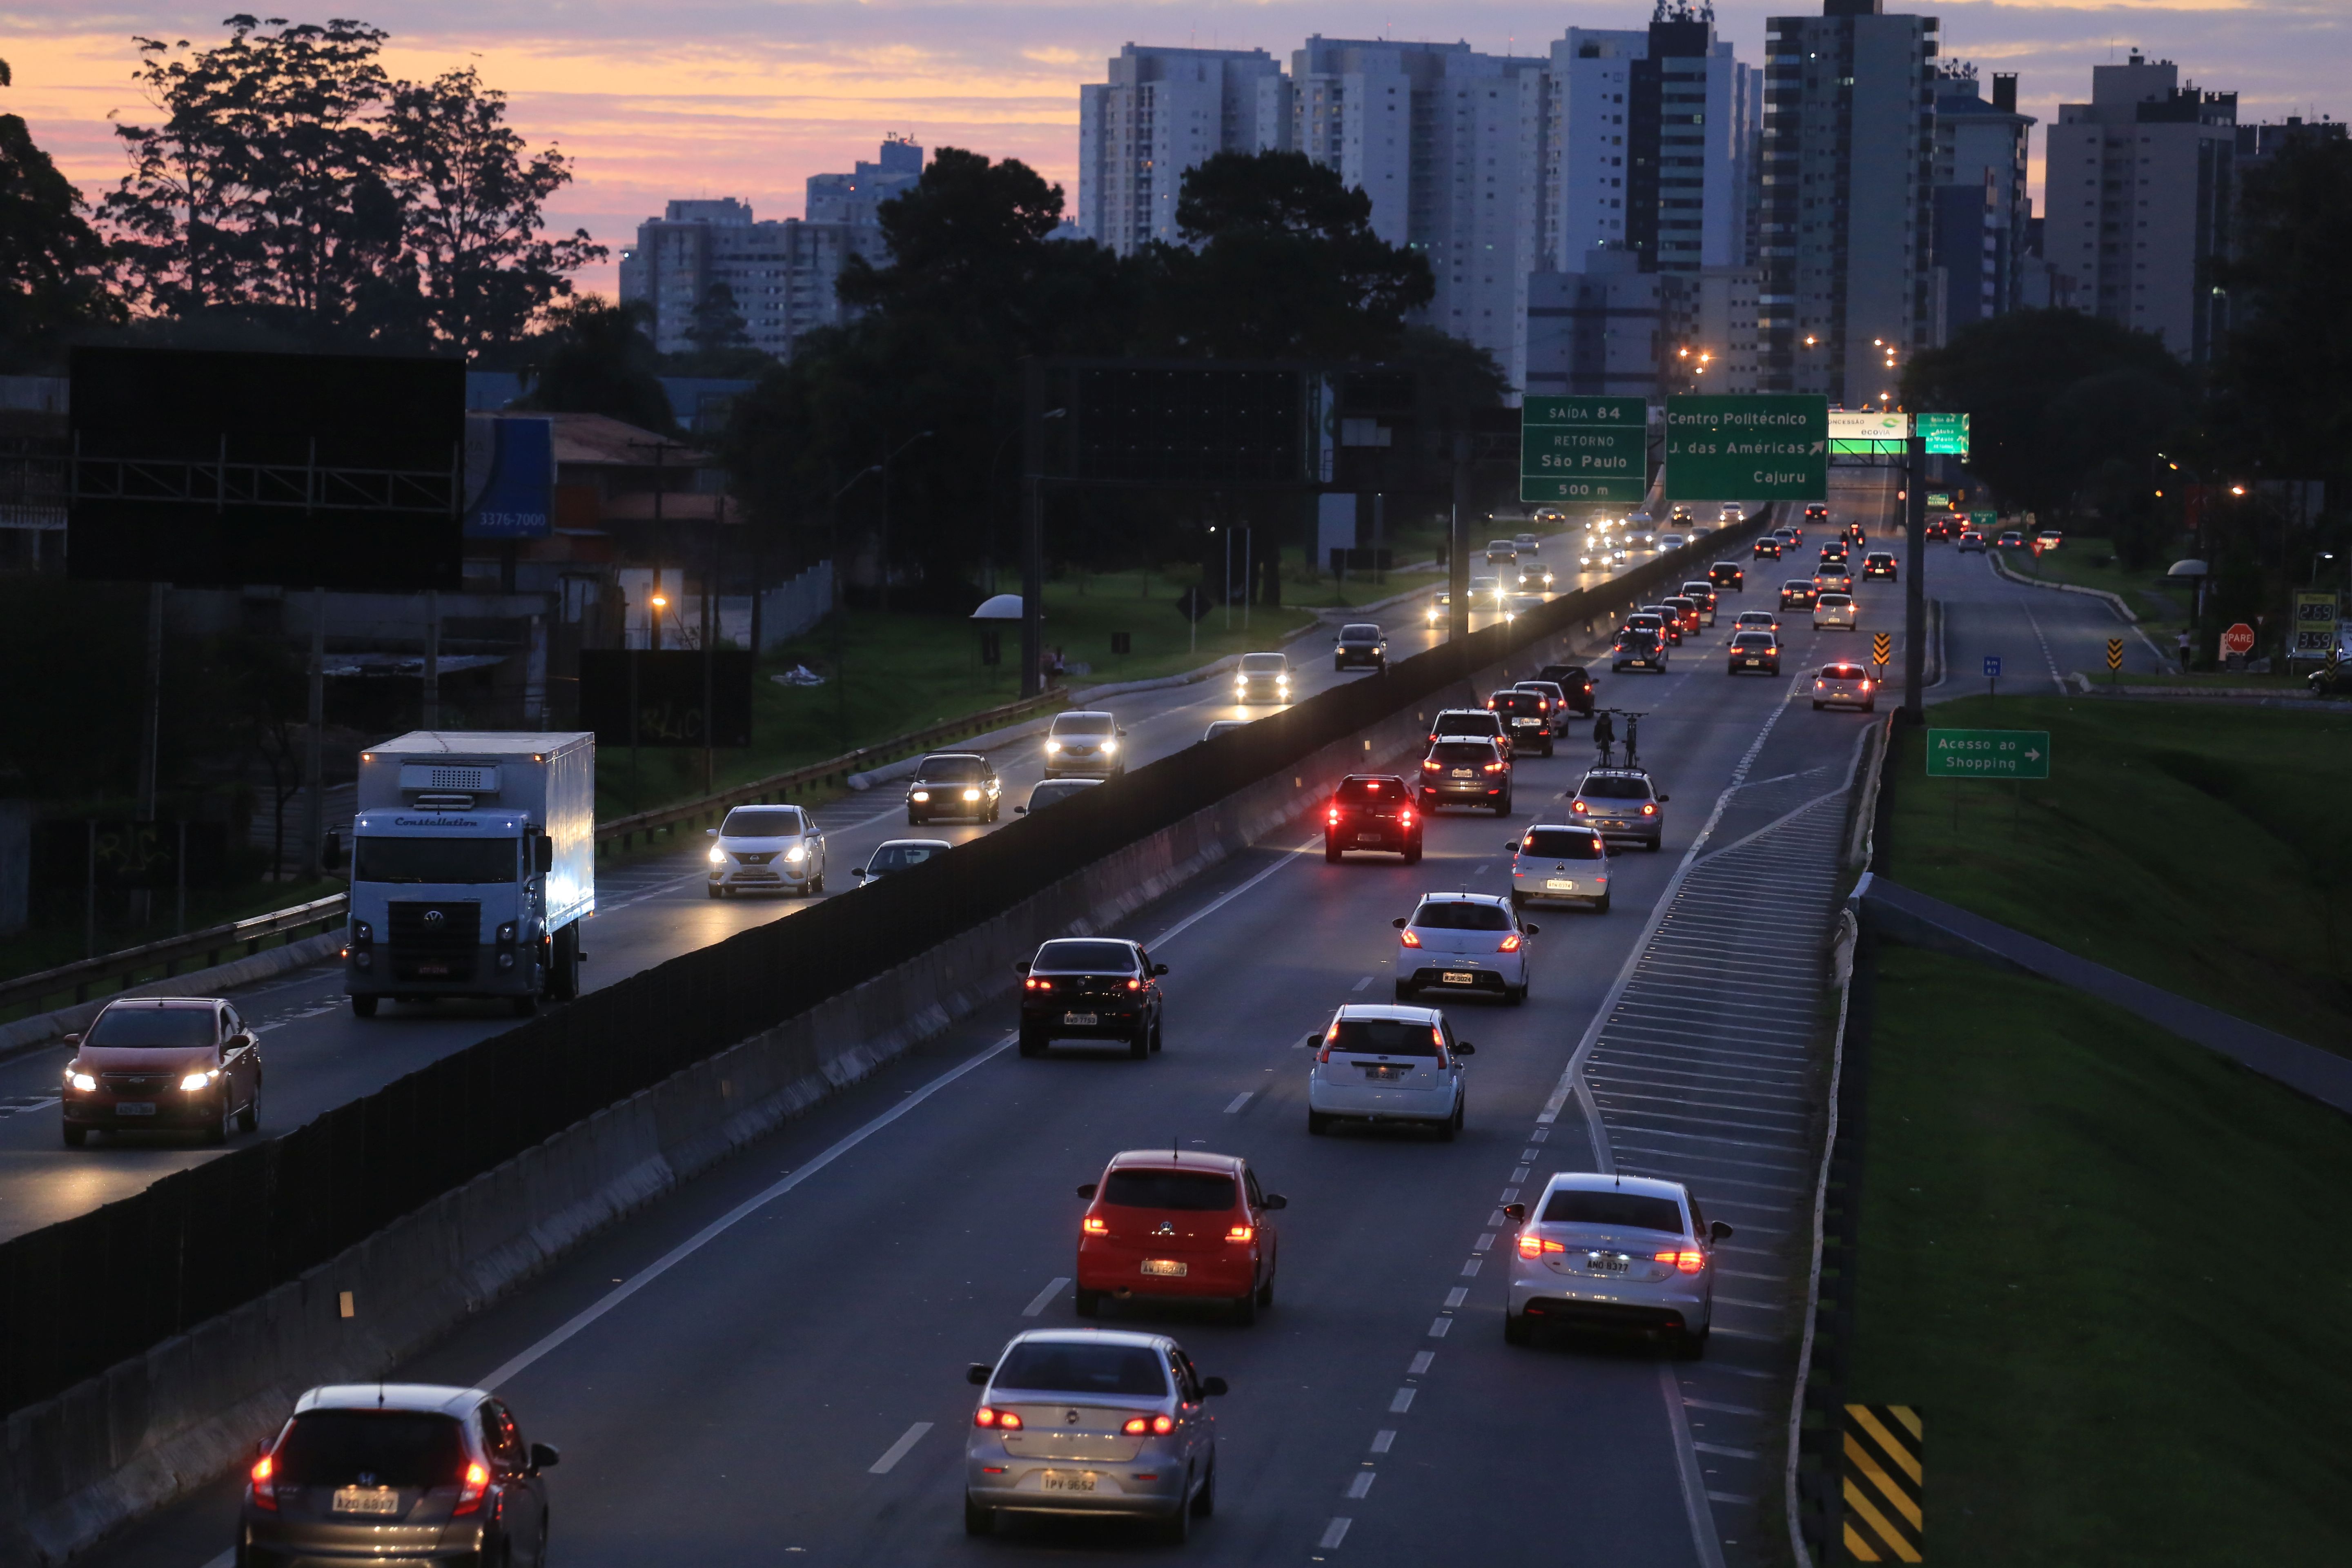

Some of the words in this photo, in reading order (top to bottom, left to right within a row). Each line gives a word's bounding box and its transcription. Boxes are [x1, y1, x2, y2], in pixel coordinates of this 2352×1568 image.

[1549, 404, 1588, 419] SAÍDA
[1597, 407, 1621, 419] 84
[1667, 412, 1718, 425] Centro
[1724, 410, 1807, 425] Politécnico
[1554, 435, 1614, 447] RETORNO
[1668, 442, 1680, 454] J.
[1688, 441, 1716, 454] das
[1726, 439, 1805, 454] Américas
[1541, 454, 1572, 467] São
[1581, 455, 1627, 468] Paulo
[1754, 470, 1806, 486] Cajuru
[1559, 484, 1589, 495] 500
[1597, 486, 1608, 495] m
[479, 512, 546, 526] 3376-7000
[2299, 605, 2332, 620] 2.69
[2228, 633, 2252, 643] PARE
[2299, 633, 2331, 648] 3.59
[1938, 738, 1991, 749] Acesso
[1999, 742, 2016, 750] ao
[1946, 756, 2016, 771] Shopping
[394, 817, 477, 826] Constellation
[1606, 1262, 1628, 1272] 8377
